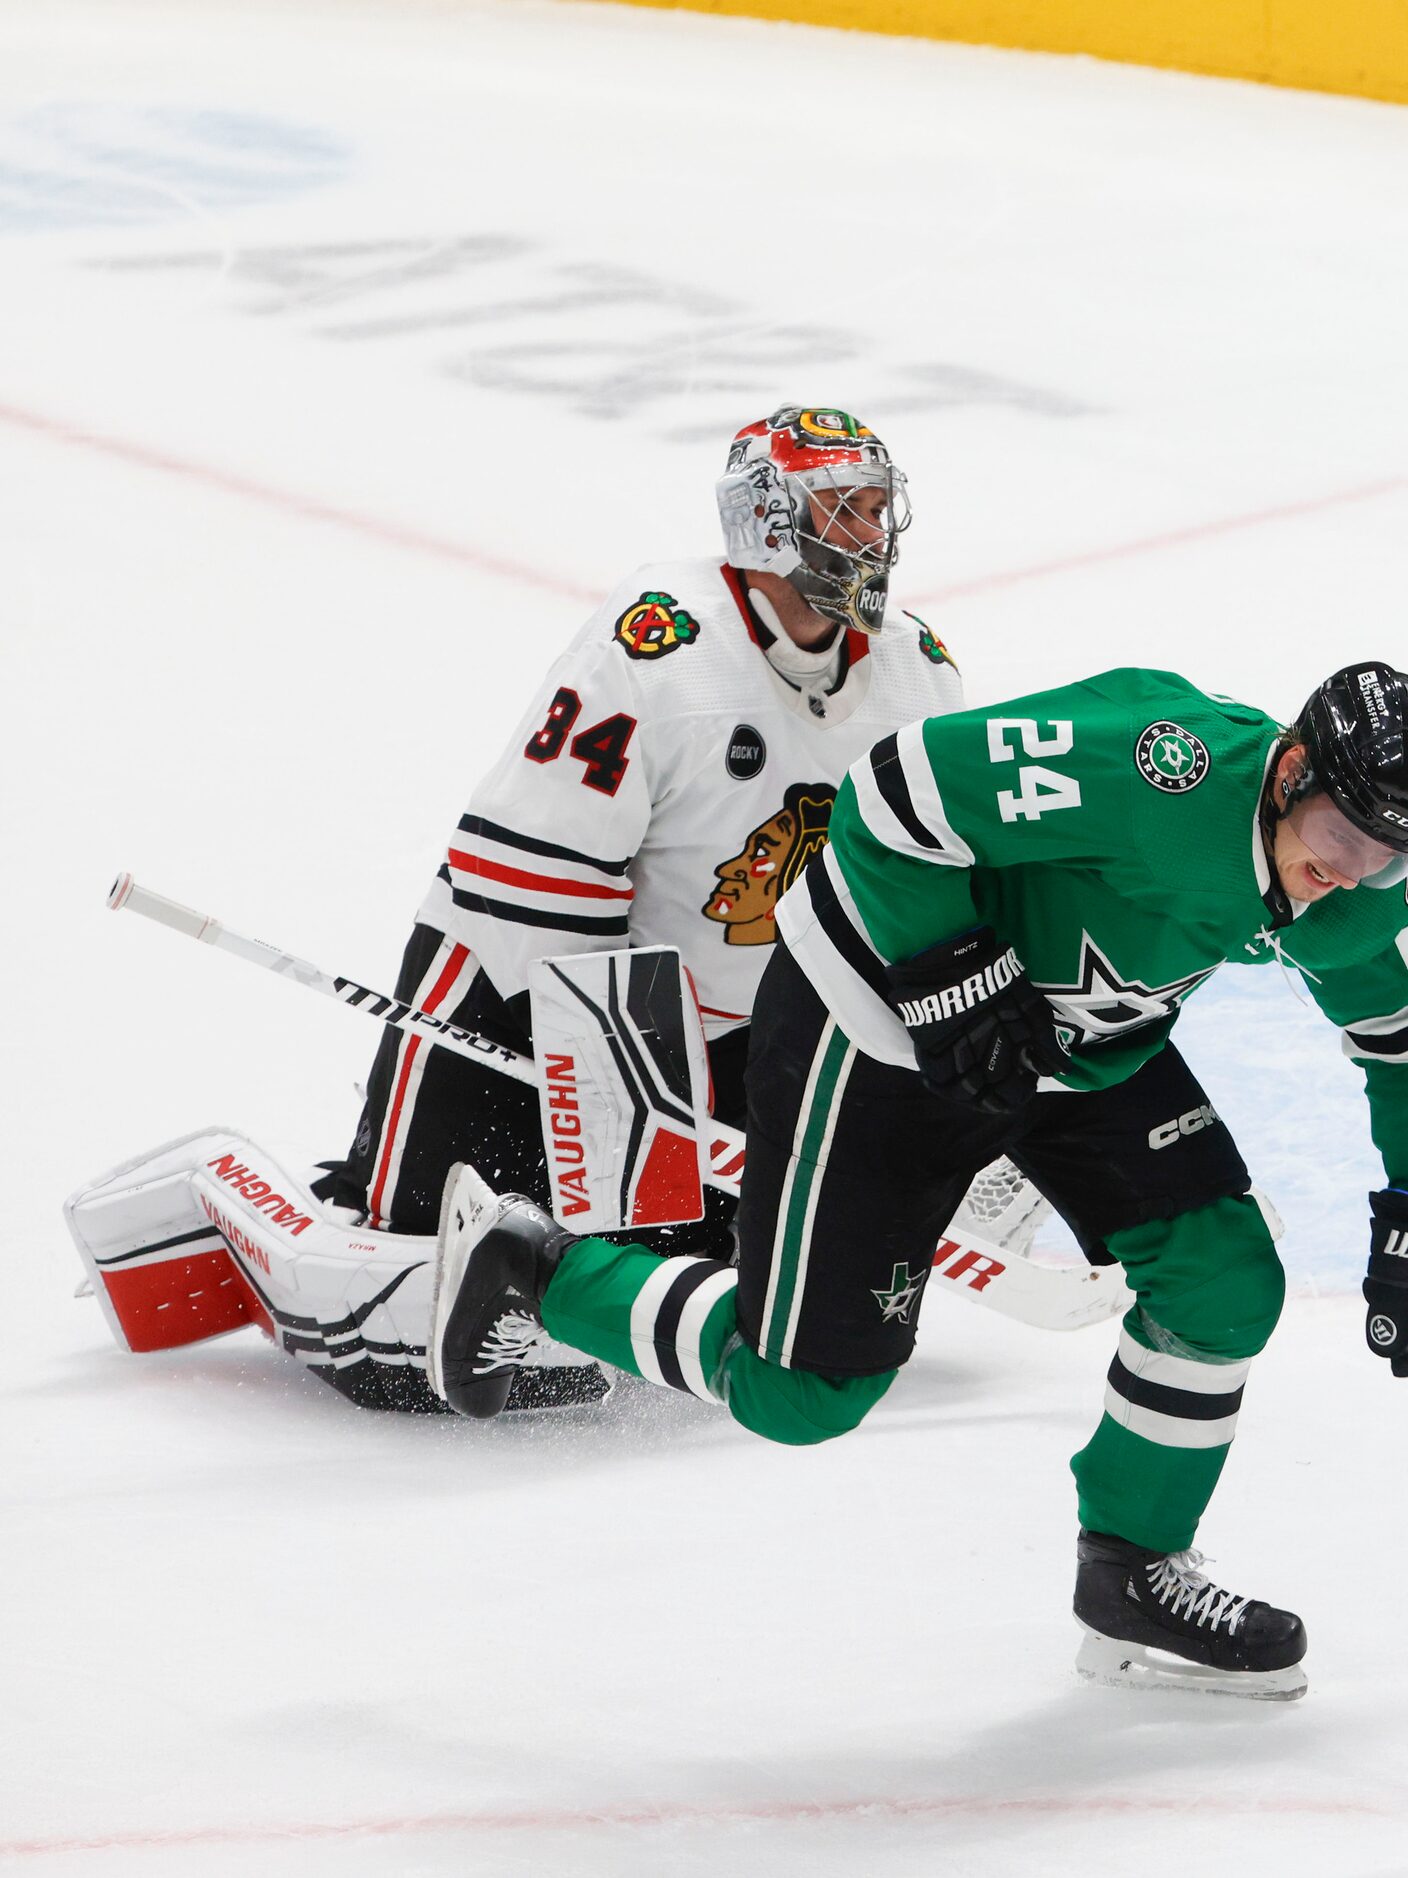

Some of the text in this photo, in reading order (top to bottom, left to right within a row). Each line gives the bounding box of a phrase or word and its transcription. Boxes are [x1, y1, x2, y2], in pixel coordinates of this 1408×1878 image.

[1369, 682, 1389, 716] ENERGY
[524, 686, 638, 798] 34
[730, 744, 760, 760] ROCKY
[986, 717, 1082, 823] 24
[1140, 727, 1163, 784] STARS
[1175, 728, 1205, 787] DALLAS
[953, 941, 978, 956] HINTZ
[898, 947, 1026, 1027] WARRIOR
[544, 1053, 592, 1218] VAUGHN
[1148, 1103, 1222, 1150] CCM
[206, 1152, 314, 1237] VAUGHN
[199, 1194, 271, 1276] VAUGHN
